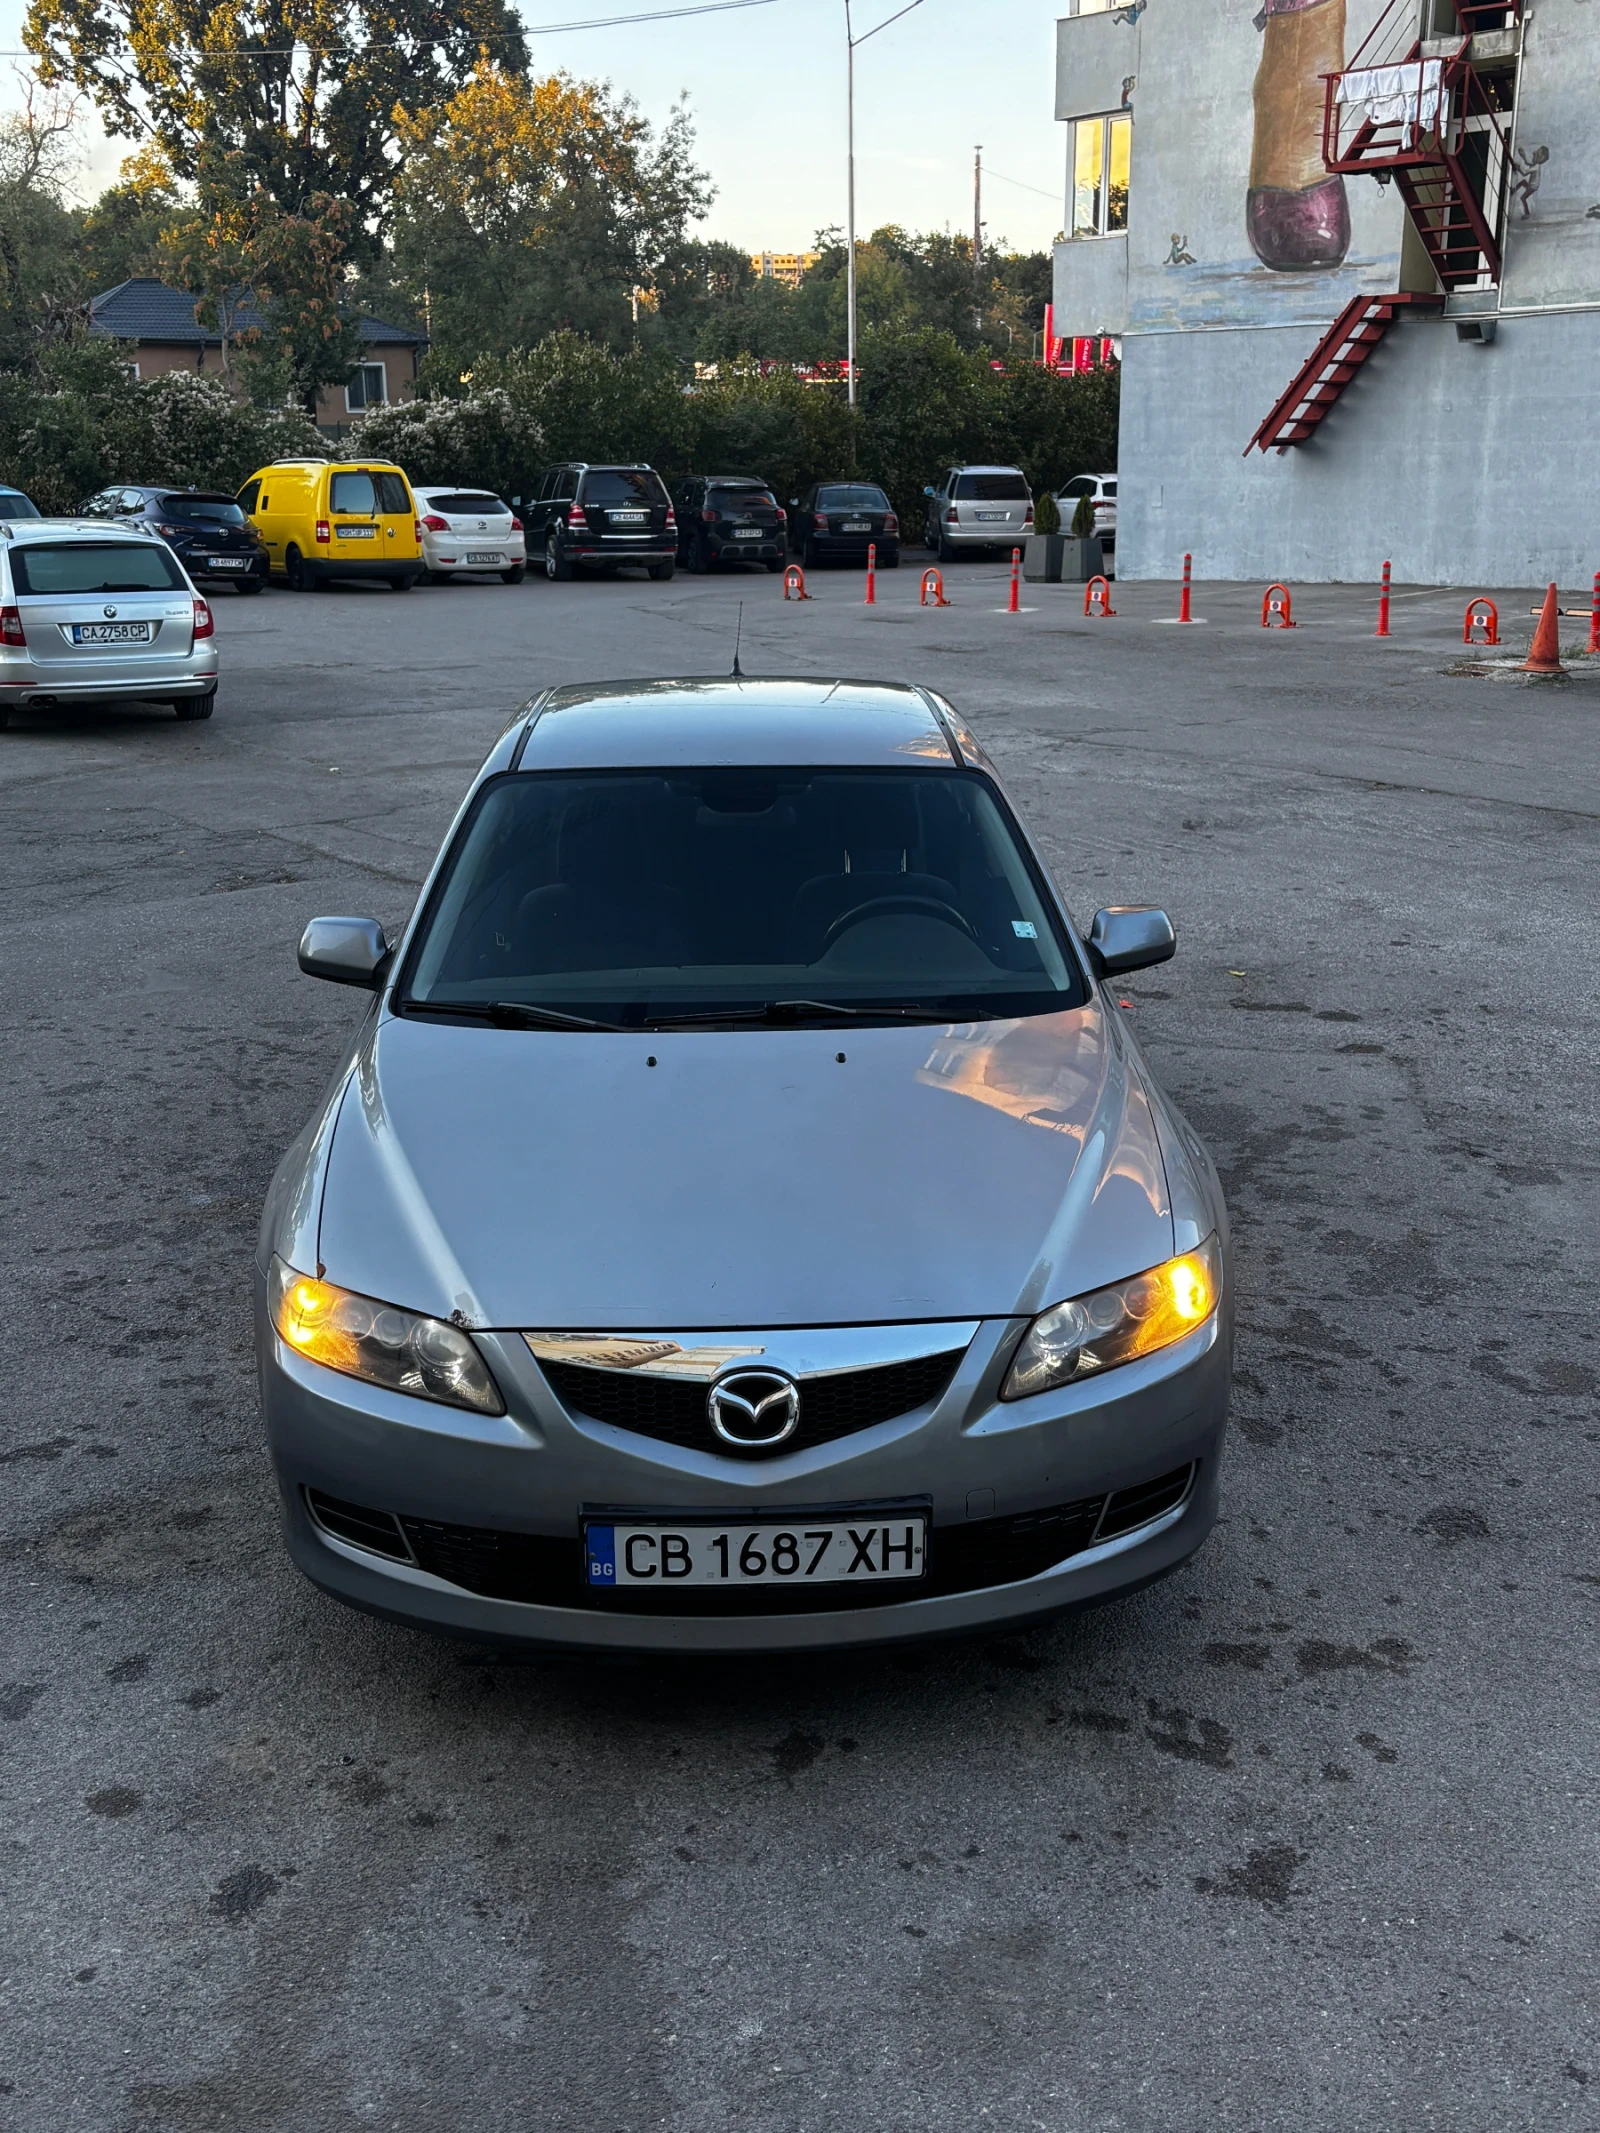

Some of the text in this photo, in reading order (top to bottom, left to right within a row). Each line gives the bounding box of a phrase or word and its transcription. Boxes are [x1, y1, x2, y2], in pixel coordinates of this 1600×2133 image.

[82, 627, 97, 639] CA
[100, 626, 128, 638] 2758
[131, 625, 146, 637] CP
[625, 1526, 914, 1578] CB 1687 XH
[592, 1563, 613, 1577] BG
